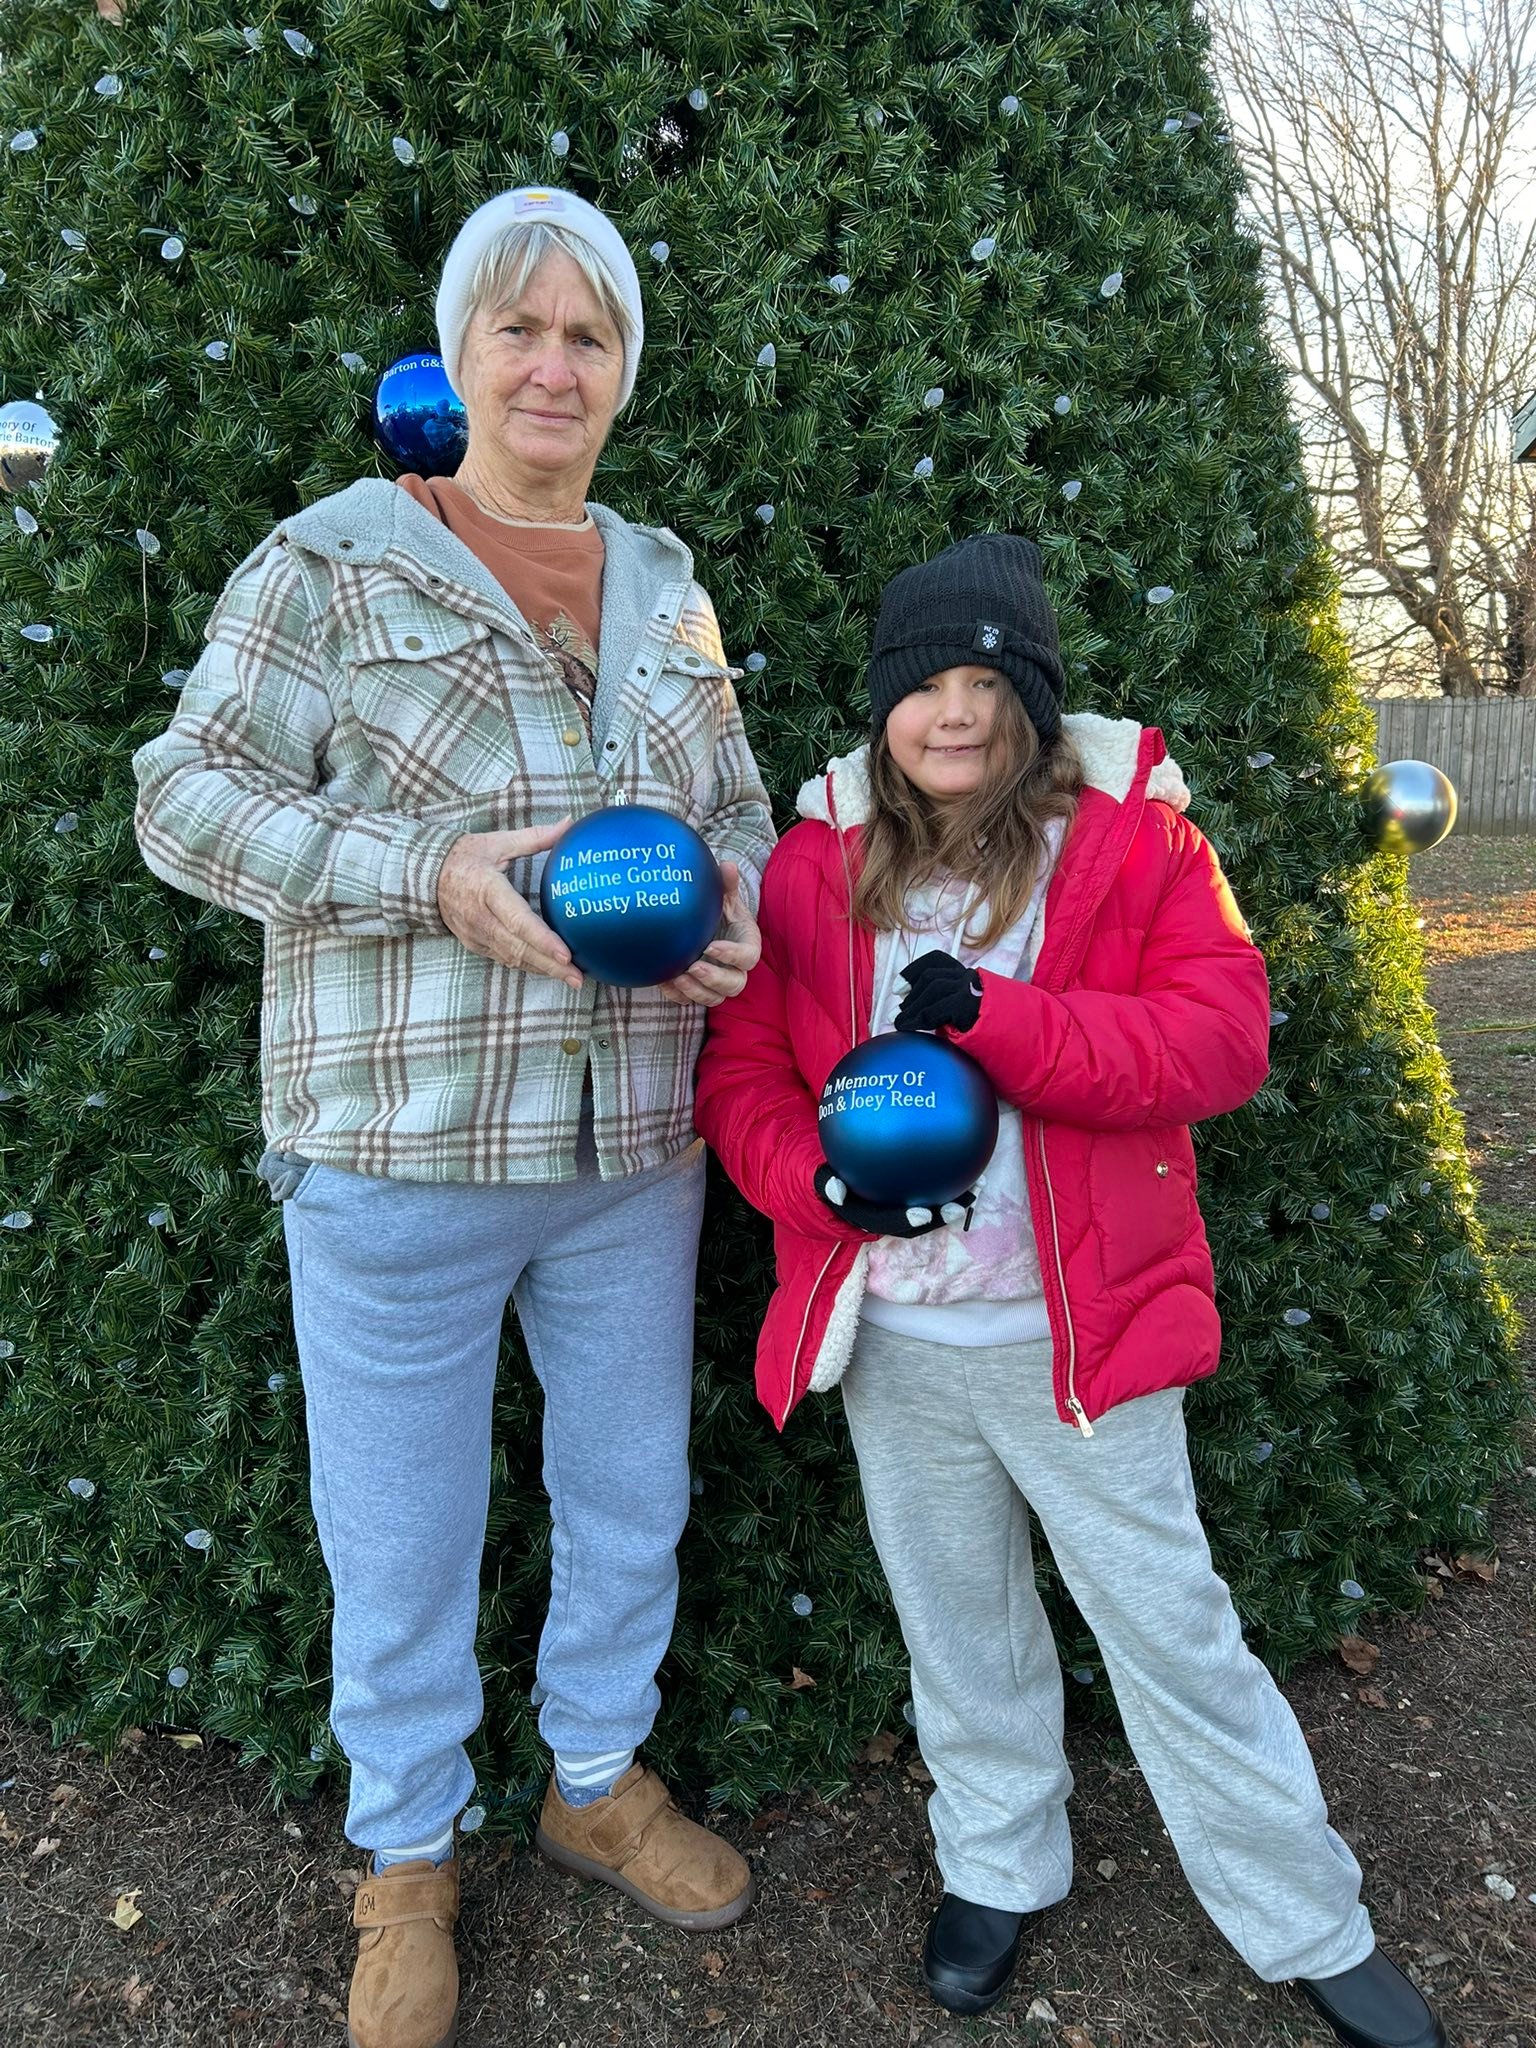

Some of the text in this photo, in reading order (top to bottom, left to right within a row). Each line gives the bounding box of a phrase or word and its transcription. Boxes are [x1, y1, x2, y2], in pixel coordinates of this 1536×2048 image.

[383, 361, 418, 382] Barton
[0, 421, 37, 432] ory Of
[15, 432, 55, 449] Barton
[560, 843, 676, 872] In Memory Of
[551, 864, 694, 900] Madeline Gordon
[564, 887, 681, 919] & Dusty Reed
[823, 1071, 926, 1099] In Memory Of
[818, 1090, 937, 1121] Don & Joey Reed
